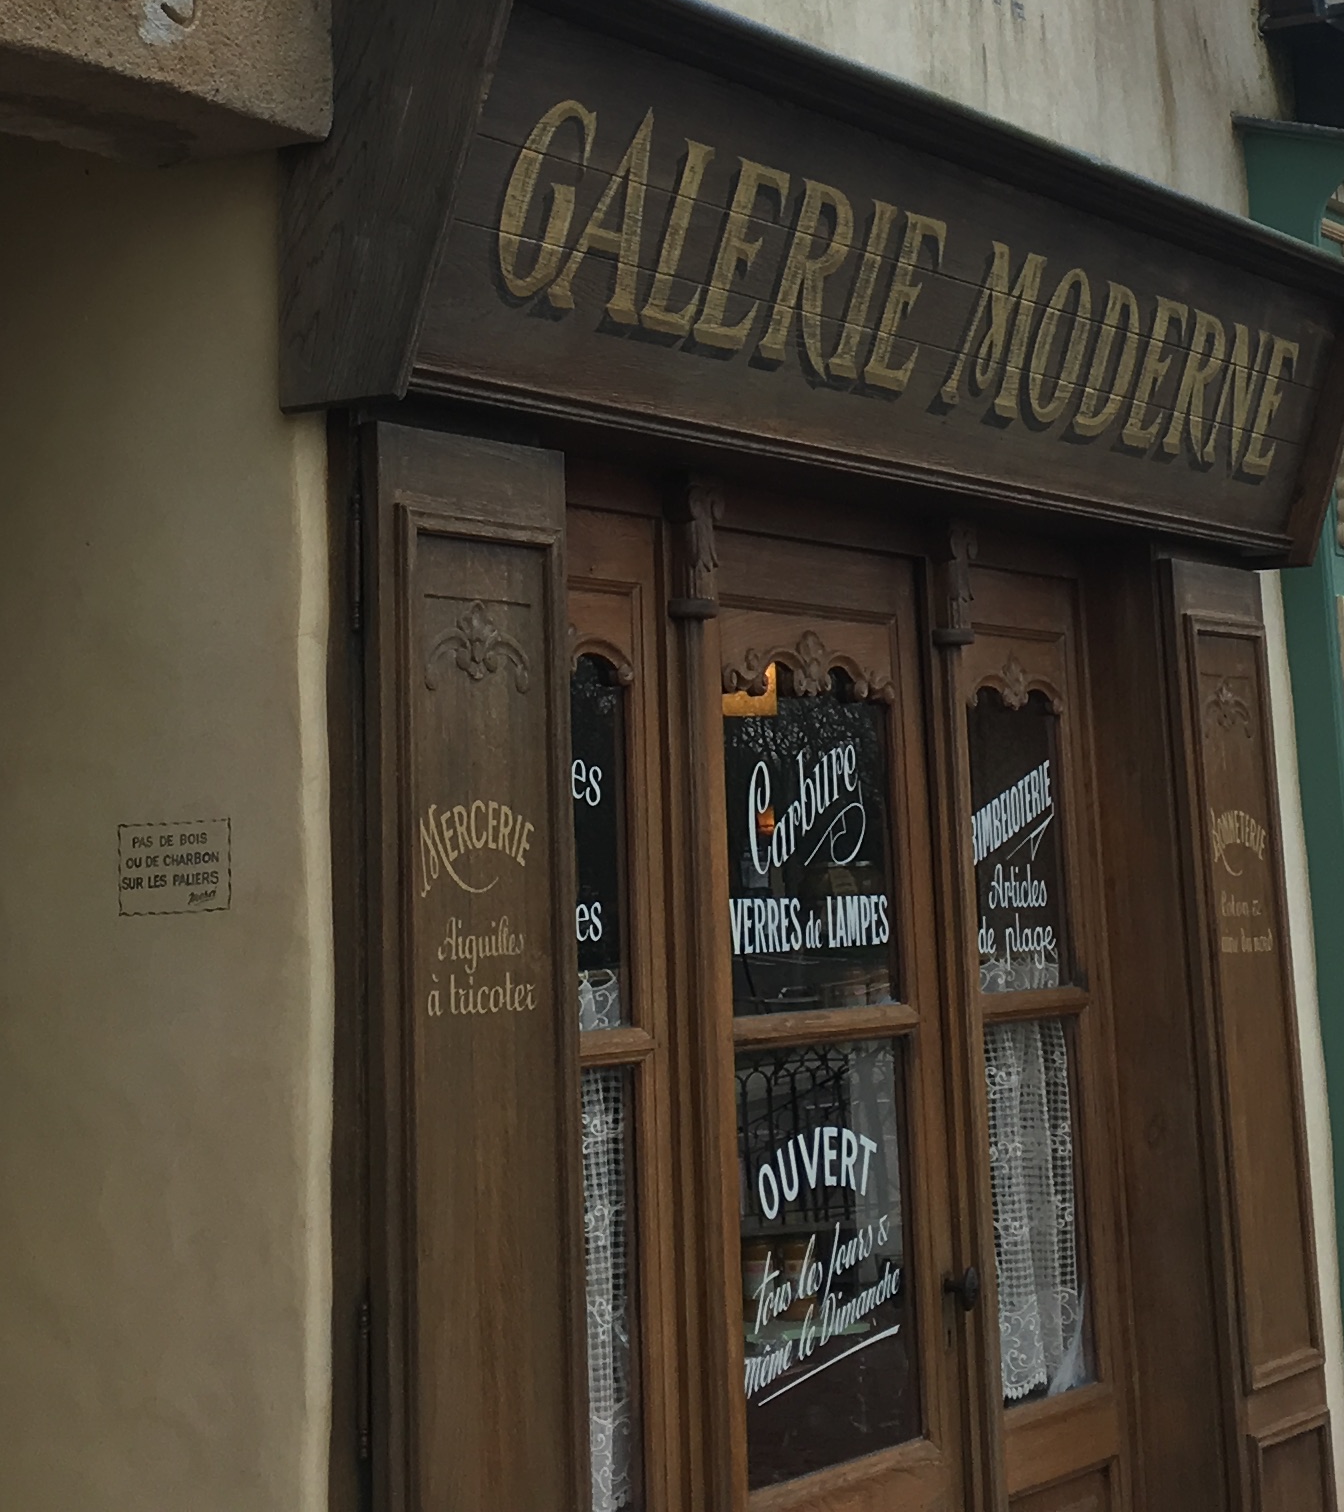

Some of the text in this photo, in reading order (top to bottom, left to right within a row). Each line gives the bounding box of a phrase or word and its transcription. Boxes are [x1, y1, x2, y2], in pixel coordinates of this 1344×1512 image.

[494, 98, 1300, 480] GALERIE MODERNE
[748, 743, 859, 876] Carbure
[125, 851, 220, 869] OU DE CHARBON
[131, 832, 208, 849] PAS DE BOIS
[121, 870, 219, 890] SUR LES PALIERS
[987, 862, 1048, 909] Articles
[436, 914, 526, 974] Aiguilles
[728, 894, 890, 955] VERRES de LAMPES
[977, 913, 1057, 970] de plage
[427, 972, 537, 1017] à tricoter
[757, 1126, 878, 1220] OUVERT
[797, 1233, 823, 1300] les
[798, 1303, 816, 1361] le
